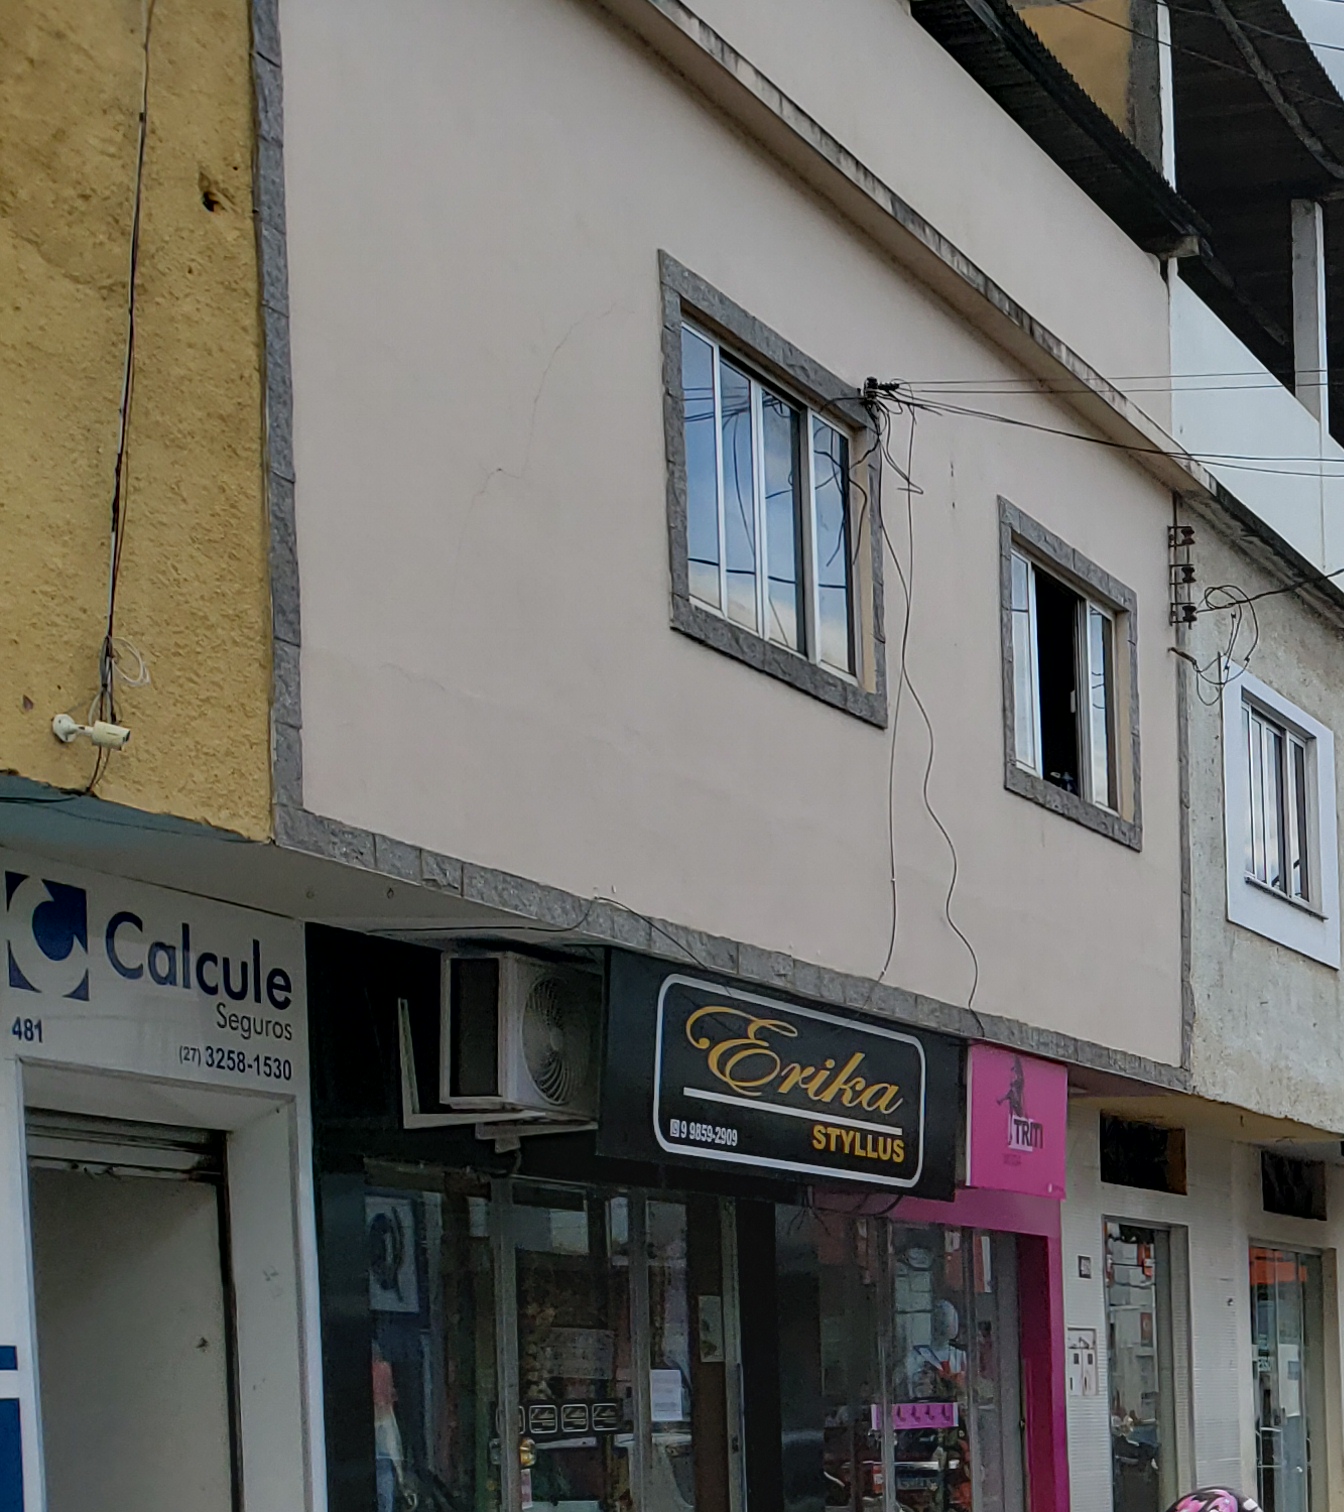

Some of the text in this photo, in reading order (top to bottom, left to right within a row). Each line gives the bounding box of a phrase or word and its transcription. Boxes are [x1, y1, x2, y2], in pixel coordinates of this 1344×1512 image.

[105, 910, 293, 1011] Calcule
[11, 1016, 43, 1043] 481
[215, 1002, 293, 1041] Seguros
[178, 1045, 293, 1081] (27) 3258-1530
[685, 1005, 904, 1115] Erika
[811, 1124, 905, 1163] STYLLUS
